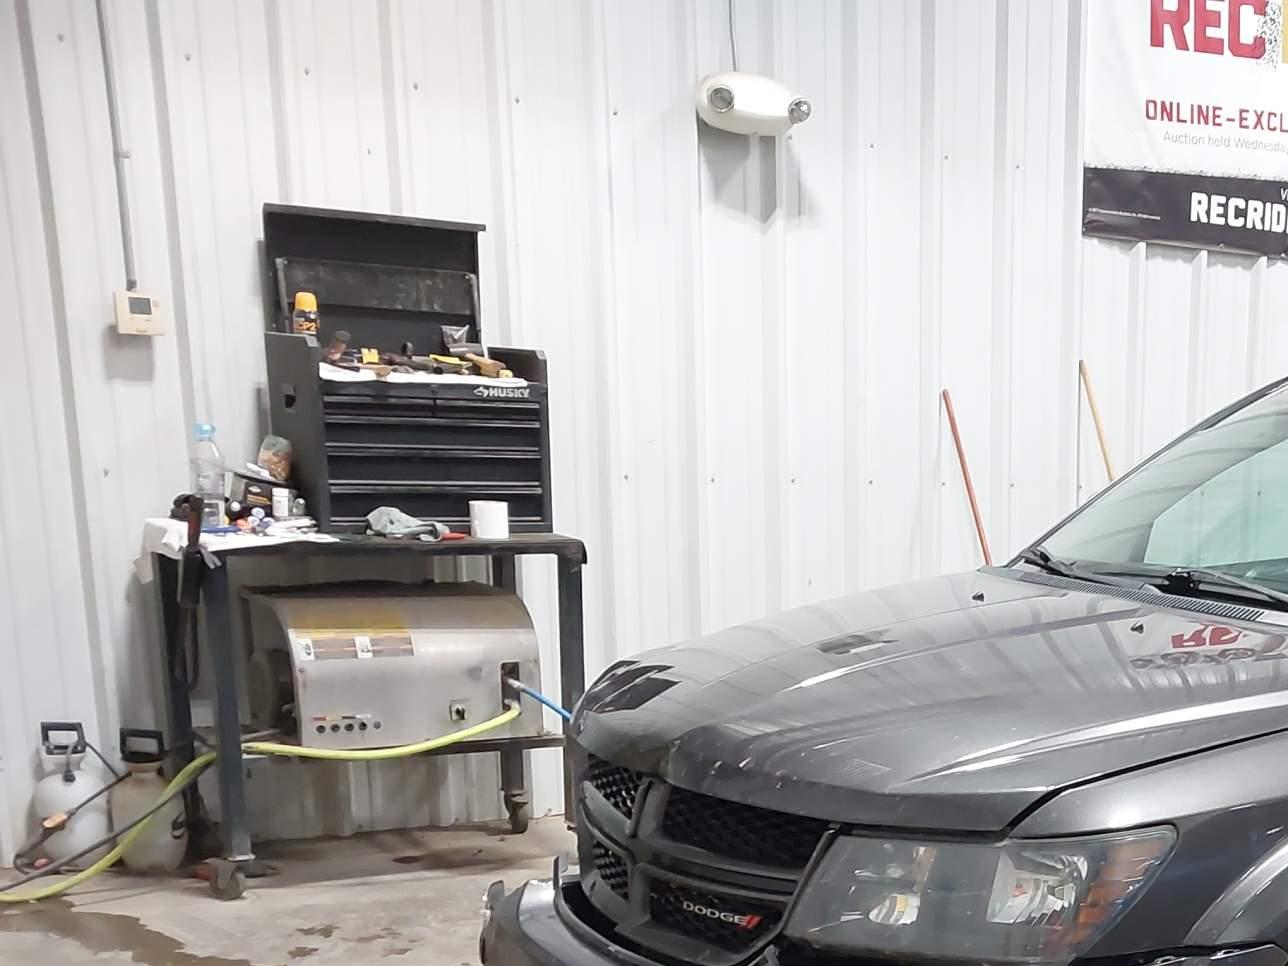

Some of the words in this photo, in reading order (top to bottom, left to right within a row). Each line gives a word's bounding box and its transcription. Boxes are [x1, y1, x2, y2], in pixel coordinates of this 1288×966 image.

[1163, 130, 1206, 146] Auction
[1207, 135, 1231, 148] held
[489, 387, 531, 399] HUSKY
[682, 900, 748, 926] DODGE
